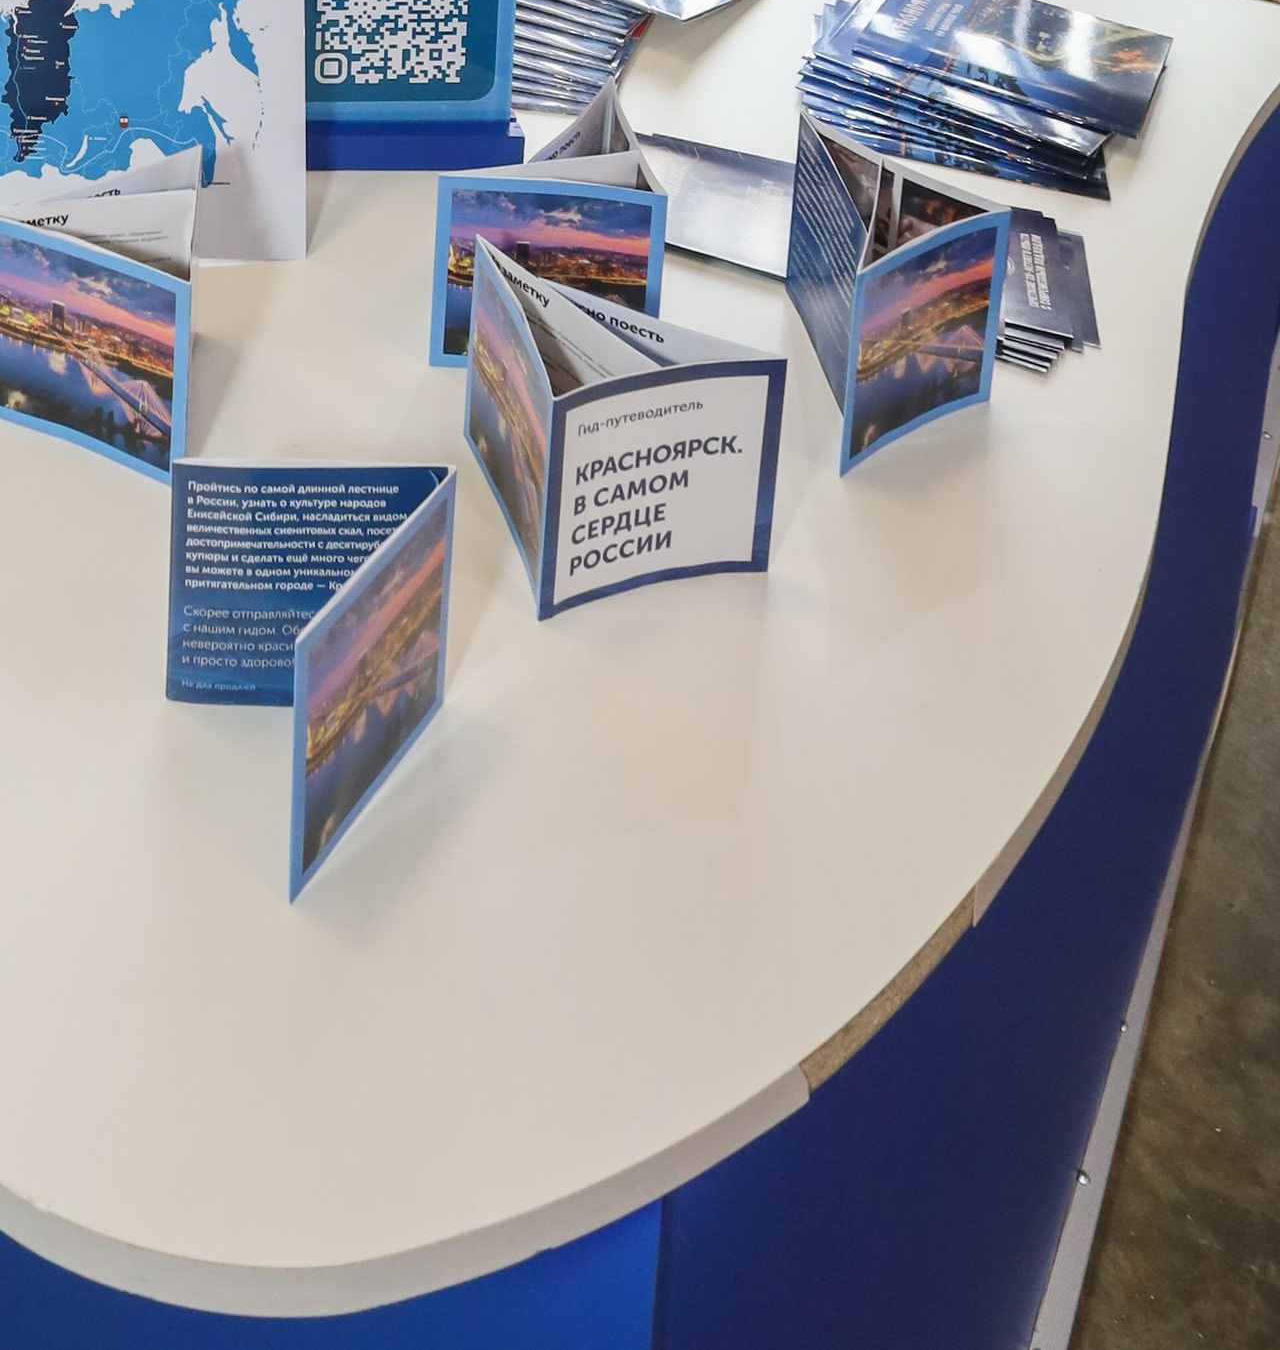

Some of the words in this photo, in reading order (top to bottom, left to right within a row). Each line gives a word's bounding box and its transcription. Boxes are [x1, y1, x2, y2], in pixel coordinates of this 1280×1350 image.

[610, 316, 665, 344] поесть
[578, 401, 704, 437] Гид-путеводитель
[575, 435, 743, 485] КРАСНОЯРСК.
[187, 480, 241, 495] Пройтись
[244, 484, 258, 495] по
[261, 482, 295, 494] самой
[298, 483, 345, 495] длинной
[348, 485, 399, 495] лестнице
[573, 495, 586, 516] В
[593, 469, 689, 507] САМОМ
[187, 497, 194, 506] в
[197, 495, 239, 508] России,
[242, 499, 277, 510] узнать
[279, 500, 287, 508] о
[290, 499, 337, 511] культуре
[340, 499, 386, 509] народов
[187, 508, 252, 522] Енисейской
[255, 511, 299, 523] Сибири,
[303, 512, 370, 523] насладиться
[373, 512, 408, 522] видом
[186, 524, 272, 536] величественных
[274, 526, 336, 536] сиенитовых
[338, 526, 364, 537] скал,
[571, 503, 667, 545] СЕРДЦЕ
[185, 537, 315, 550] достопримечательности
[317, 541, 324, 549] с
[185, 552, 229, 564] купюры
[232, 553, 238, 562] и
[241, 554, 284, 565] сделать
[286, 553, 308, 563] ещё
[311, 554, 345, 564] много
[569, 530, 672, 577] РОССИИ
[185, 565, 199, 574] вы
[202, 566, 243, 576] можете
[246, 568, 253, 576] в
[255, 568, 290, 578] одном
[185, 579, 273, 592] притягательном
[275, 581, 314, 592] городе
[183, 605, 229, 620] Скорее
[183, 624, 190, 632] с
[193, 624, 235, 635] нашим
[182, 641, 255, 653] невероятно
[193, 656, 237, 667] просто
[182, 680, 194, 688] Не
[214, 682, 256, 691] продажи
